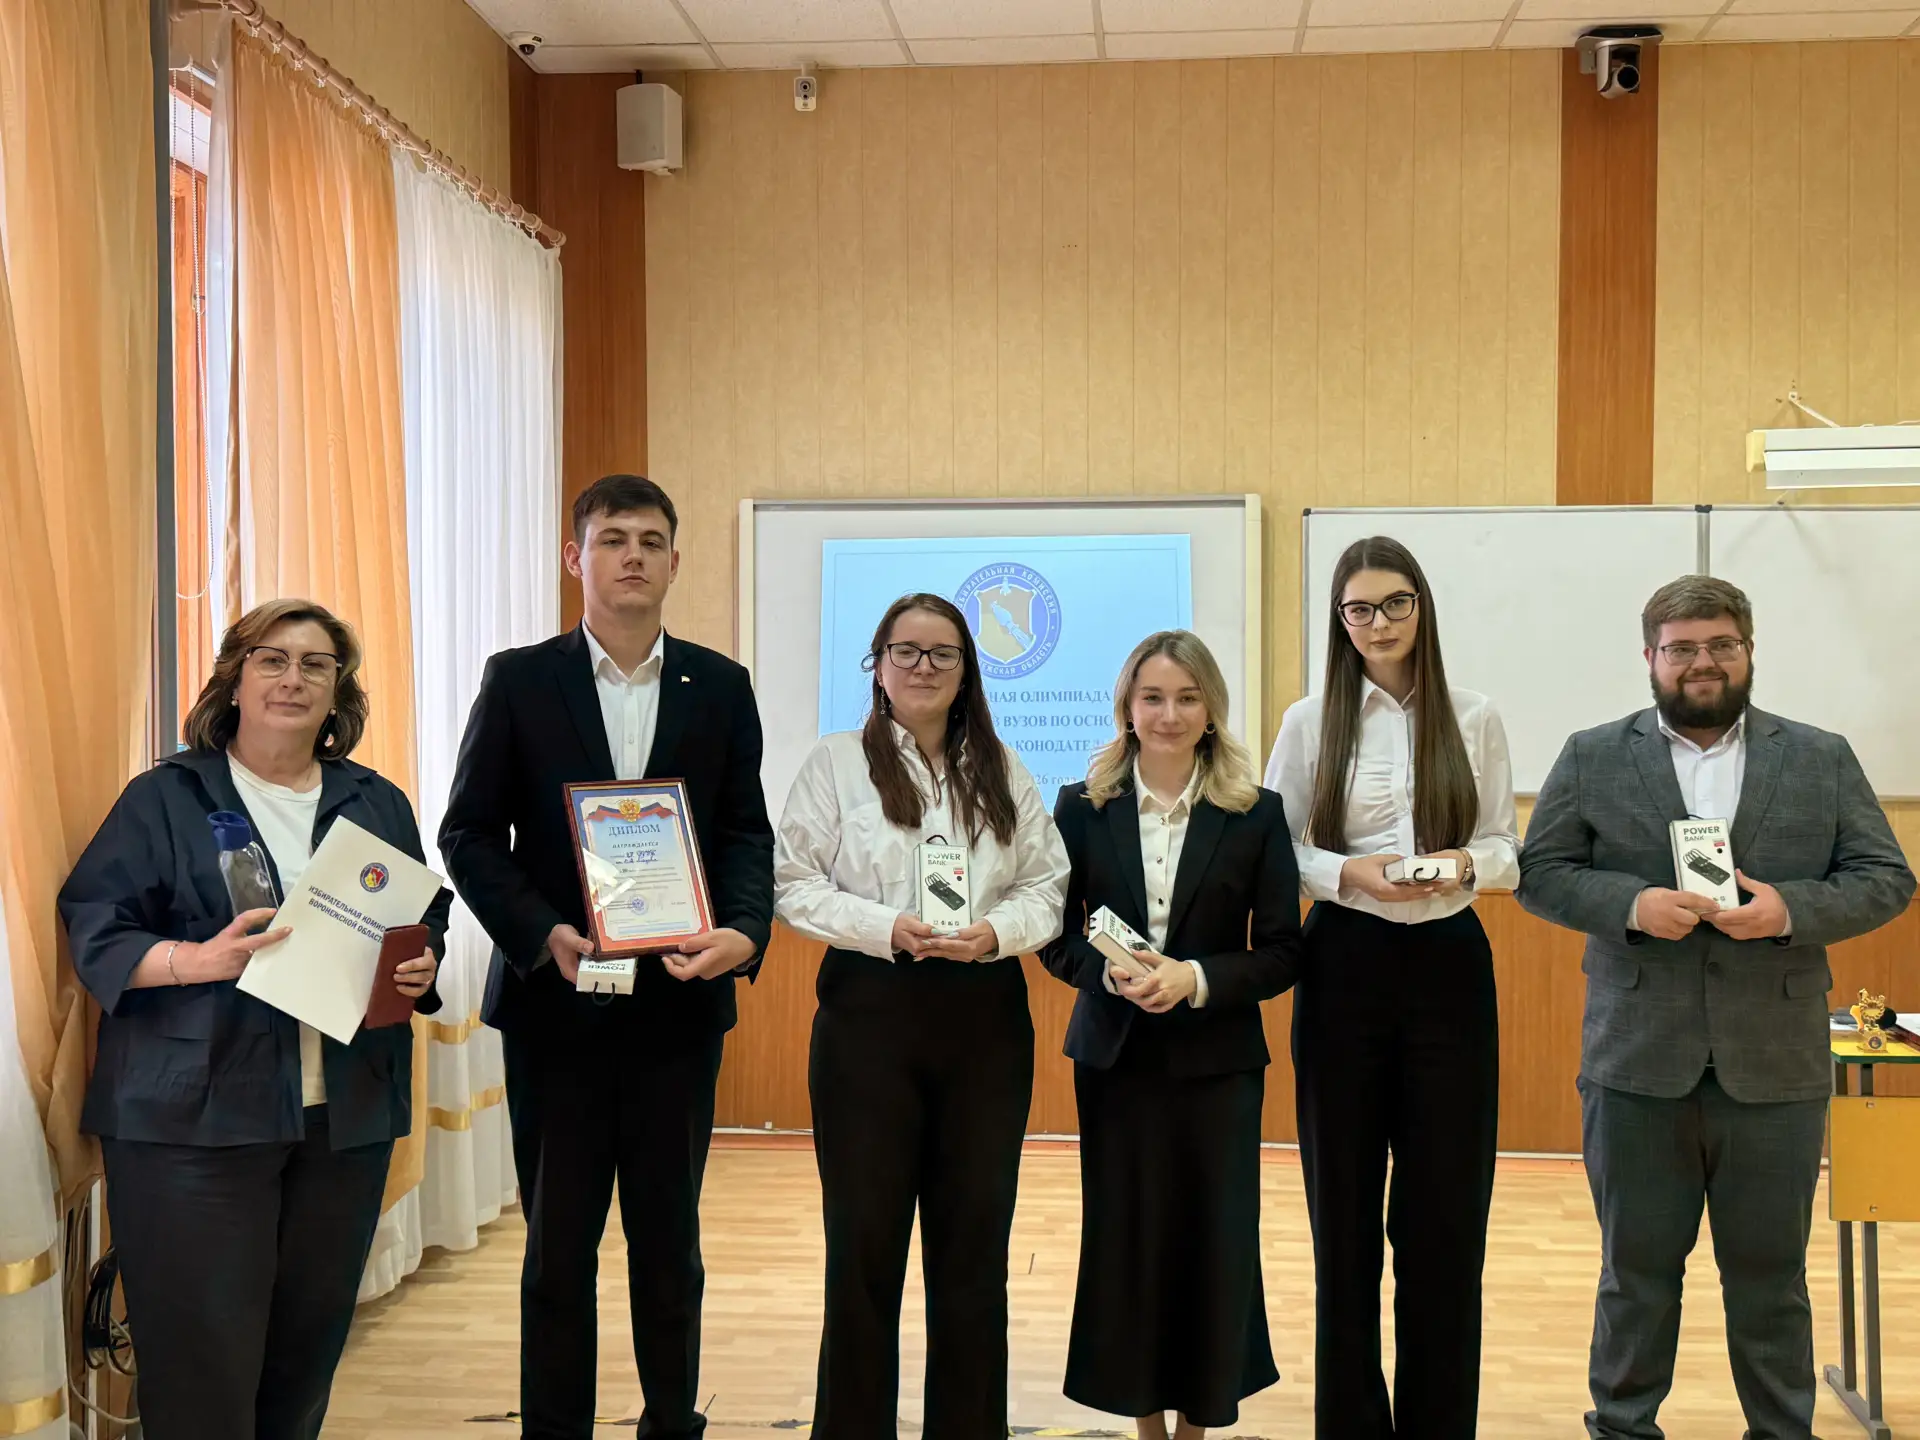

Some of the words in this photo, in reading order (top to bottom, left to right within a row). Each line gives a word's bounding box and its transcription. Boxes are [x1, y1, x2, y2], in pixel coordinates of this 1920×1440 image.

[1021, 570, 1057, 614] КОМИССИЯ
[1021, 641, 1052, 671] ОБЛАСТЬ
[989, 691, 1016, 703] НАЯ
[1020, 691, 1111, 704] ОЛИМПИАДА
[1003, 715, 1047, 727] ВУЗОВ
[1051, 715, 1071, 727] ПО
[1073, 715, 1113, 727] ОСНО
[1036, 774, 1048, 785] 26
[608, 824, 660, 837] ДИПЛОМ
[1683, 826, 1720, 835] POWER
[927, 852, 960, 861] POWER
[308, 885, 362, 919] ИЗБИРАТЕЛЬНАЯ
[361, 914, 386, 933] КОМИС
[308, 898, 358, 929] ВОРОНЕЖСКОЙ
[357, 925, 383, 943] ОБЛАСТ
